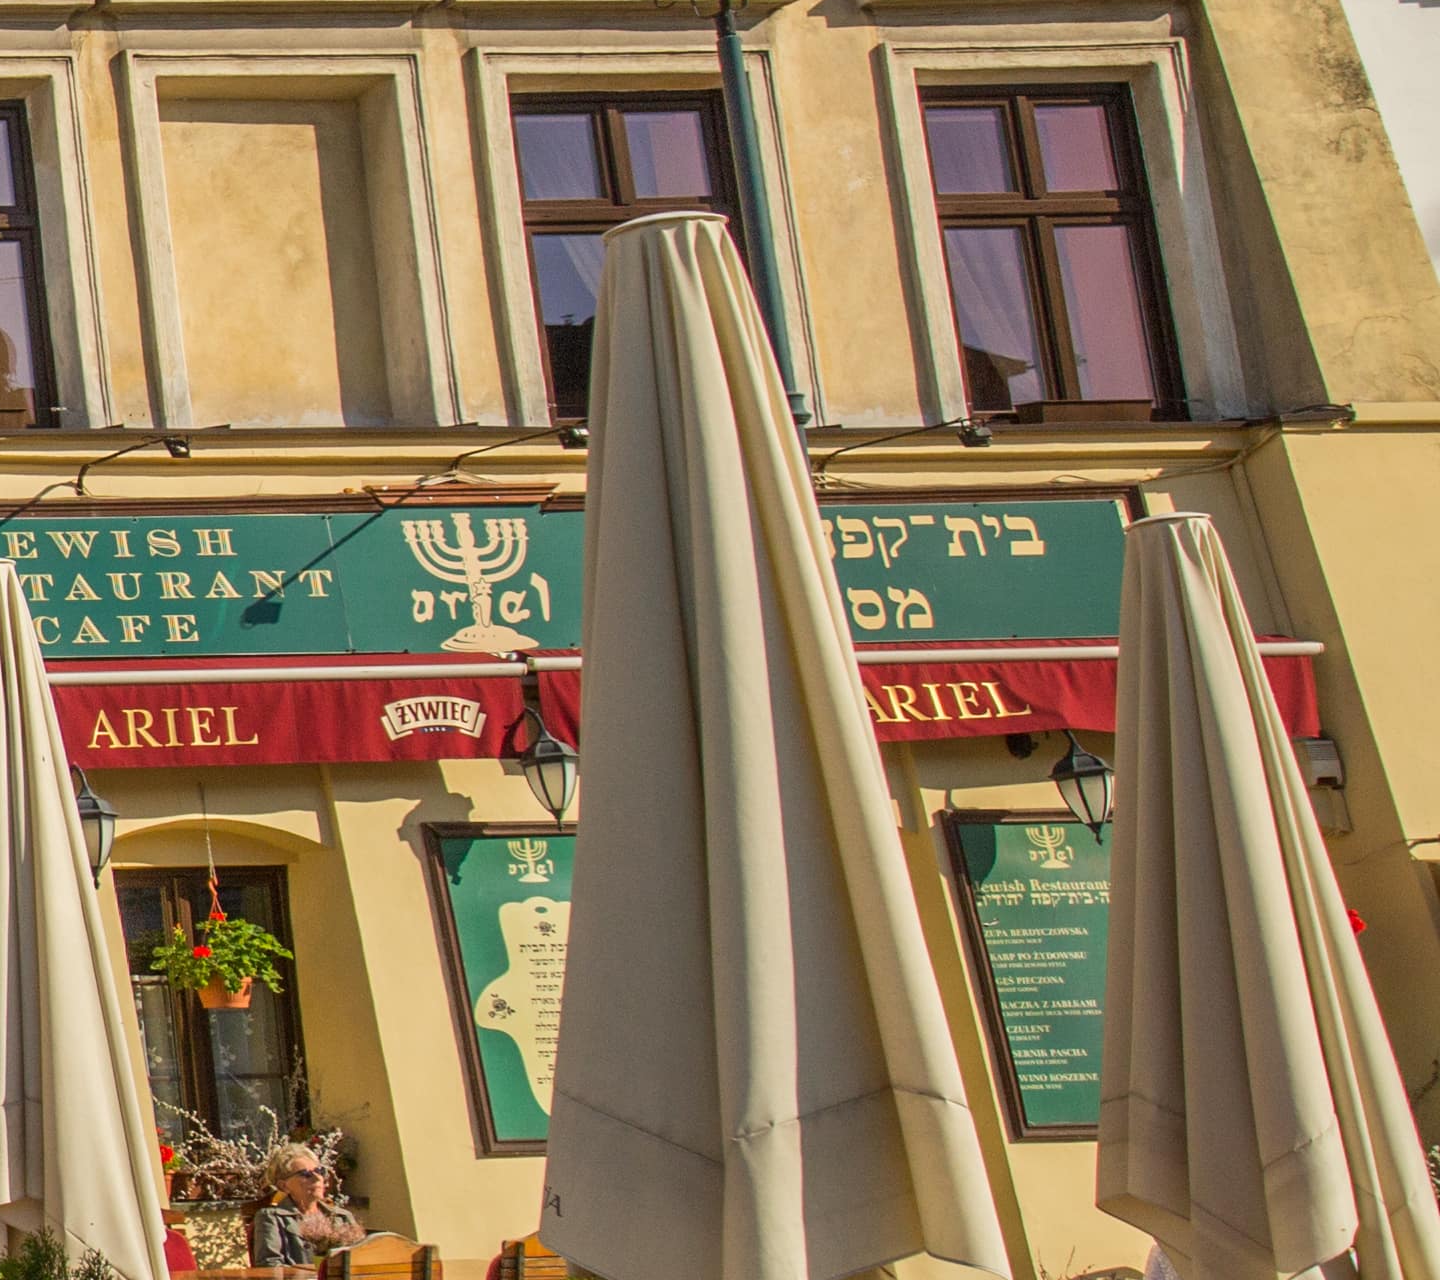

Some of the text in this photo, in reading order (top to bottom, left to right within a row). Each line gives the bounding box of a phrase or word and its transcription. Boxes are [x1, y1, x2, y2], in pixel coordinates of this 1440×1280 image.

[33, 613, 200, 646] CAFE
[394, 700, 472, 726] ŻYWIEC
[87, 705, 259, 750] ARIEL
[1017, 952, 1031, 960] PO
[1042, 1000, 1049, 1009] Z
